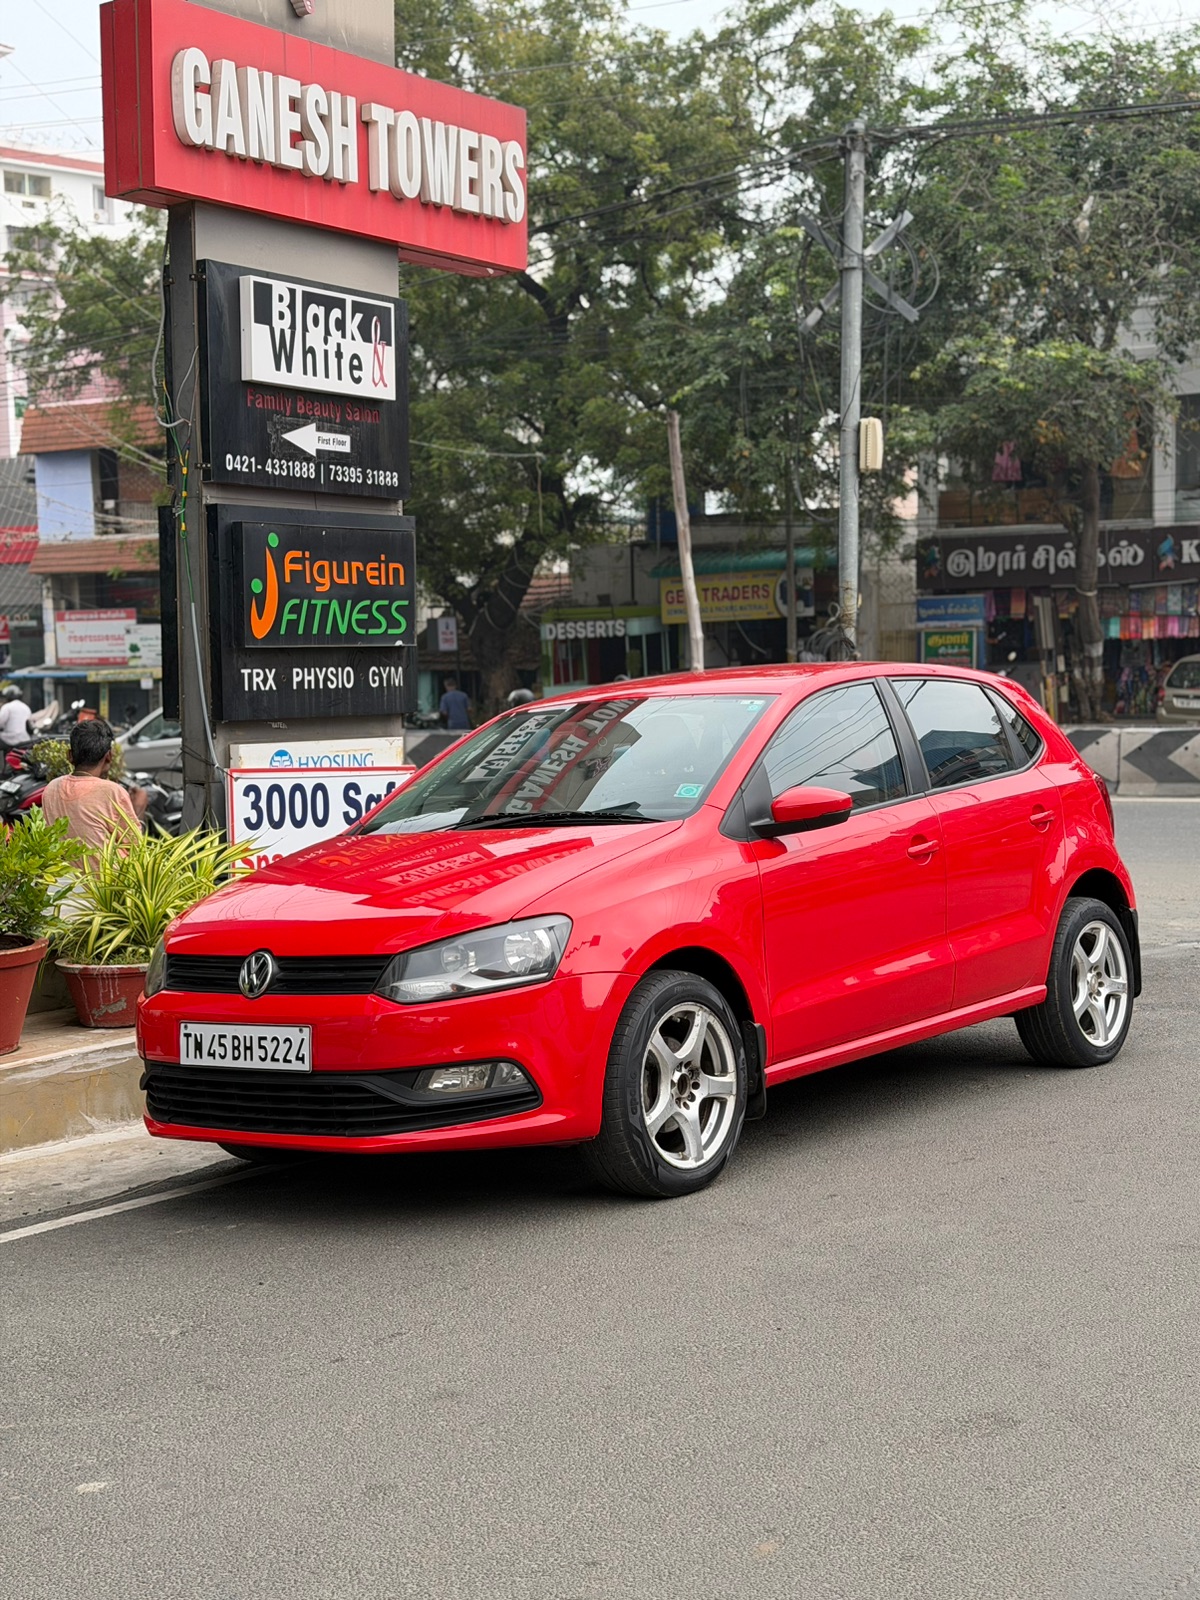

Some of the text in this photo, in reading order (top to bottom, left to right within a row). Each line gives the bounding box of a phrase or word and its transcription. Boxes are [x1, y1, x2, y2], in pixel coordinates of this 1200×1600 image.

[171, 46, 525, 224] GANESH TOWERS
[271, 284, 364, 343] Black
[268, 327, 364, 385] White
[246, 388, 381, 424] Family Beauty Salon
[317, 435, 347, 447] First Floor
[265, 458, 316, 479] 4331888
[329, 465, 363, 484] 73395
[366, 469, 399, 487] 31888
[284, 550, 406, 592] Figurein
[946, 543, 1025, 577] குமார்
[701, 583, 770, 603] TRADERS
[280, 598, 410, 635] FITNESS
[545, 619, 626, 641] DESSERTS
[241, 665, 403, 691] TRX PHYSIO GYM
[242, 782, 330, 831] 3000
